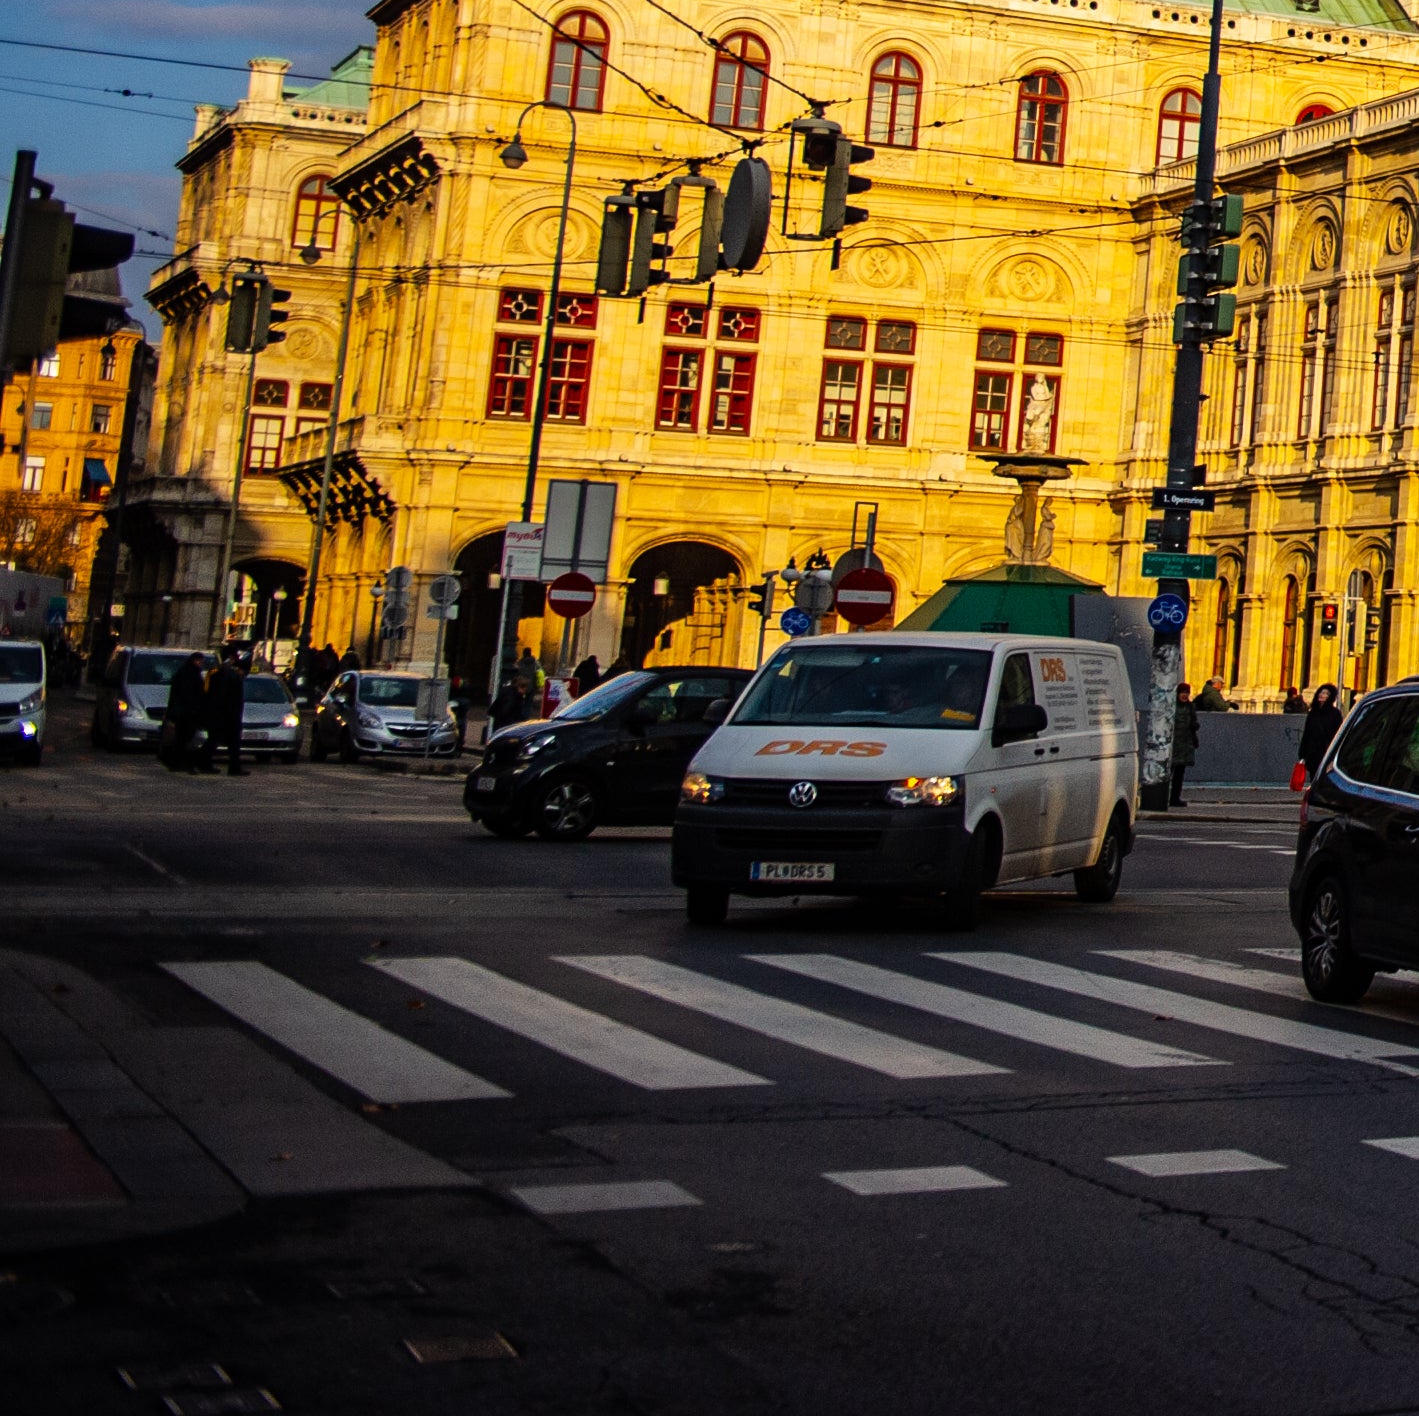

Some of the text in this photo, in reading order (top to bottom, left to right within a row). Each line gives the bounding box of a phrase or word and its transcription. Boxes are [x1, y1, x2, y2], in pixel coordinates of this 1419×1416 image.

[1171, 495, 1205, 507] Opernring
[1040, 658, 1066, 682] DRS
[754, 740, 888, 757] DRS
[766, 865, 782, 878] PL
